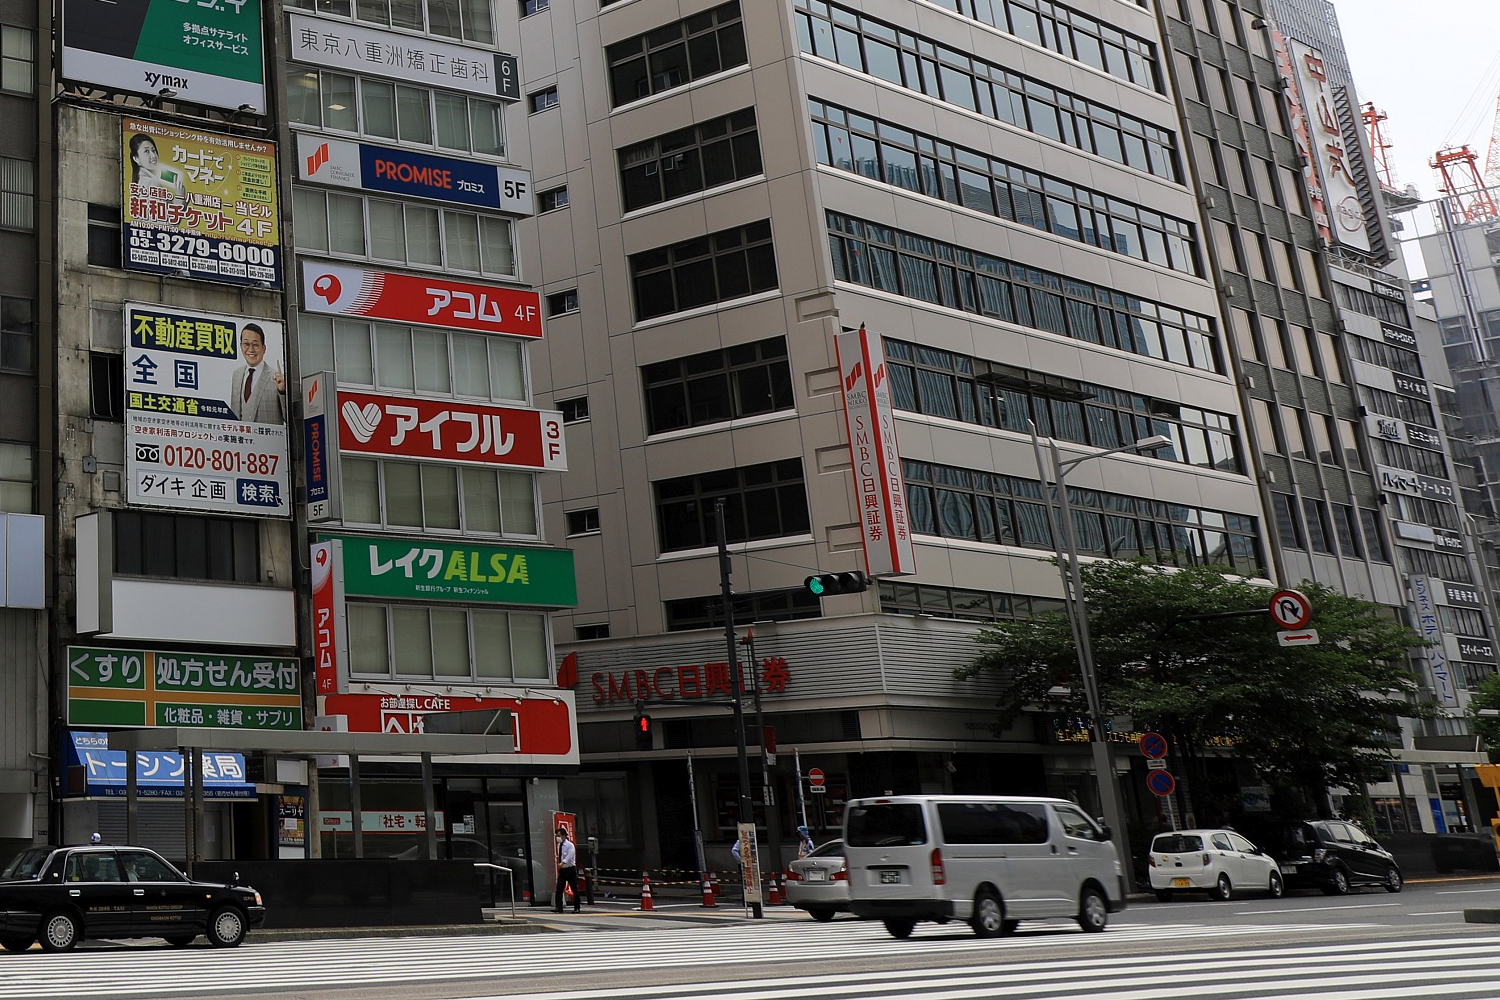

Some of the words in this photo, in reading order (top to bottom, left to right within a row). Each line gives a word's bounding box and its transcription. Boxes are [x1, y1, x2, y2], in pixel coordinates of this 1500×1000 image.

[182, 21, 248, 43] 多拠点サテライト
[182, 35, 249, 56] オフィスサービス
[299, 27, 489, 84] 東京八重洲矯正歯科
[144, 70, 188, 89] xymax
[501, 60, 511, 93] 6F
[172, 145, 224, 170] カードで
[183, 164, 225, 185] マネー
[330, 170, 355, 178] CONSUMER
[375, 159, 452, 189] PROMISE
[457, 180, 485, 194] プロミス
[504, 180, 526, 200] 5F
[185, 193, 221, 209] 八重洲店
[235, 201, 272, 219] 当ビル
[129, 197, 234, 232] 新和チケット
[130, 228, 153, 239] TEL
[236, 219, 273, 239] 4F
[130, 232, 275, 266] 03-3279-6000
[425, 287, 502, 323] アコム
[514, 304, 536, 322] 4F
[133, 314, 235, 355] 不動産買取
[132, 354, 199, 391] 全国
[129, 392, 199, 415] 国土交通省
[200, 404, 229, 415] 令和元年度
[846, 391, 867, 402] SMBC
[847, 398, 868, 409] NIKKO
[385, 405, 515, 457] アイフル
[545, 420, 561, 462] 3F
[1377, 419, 1400, 436] Hotel
[164, 444, 279, 476] 0120-801-887
[310, 422, 322, 483] PROMISE
[854, 415, 884, 542] SMBC日興証券
[882, 414, 907, 542] SMBC日興証券
[1382, 472, 1422, 493] ハイマート
[241, 482, 275, 504] 検索
[310, 486, 325, 497] プロミス
[312, 503, 324, 518] 5F
[368, 544, 530, 586] レイクALSA
[415, 584, 452, 594] 新生銀行グループ
[453, 586, 489, 596] 新生フィナンシャル
[317, 607, 332, 669] アコム
[1414, 577, 1431, 611] ビジネス
[1430, 652, 1453, 702] ハイマート
[70, 652, 141, 684] くすり
[156, 656, 298, 690] 処方せん受付
[321, 677, 332, 690] 4F
[380, 697, 422, 710] お部屋探し
[424, 698, 451, 710] CAFE
[163, 706, 293, 726] 化粧品・雑貨・サプリ
[85, 751, 243, 778] トーシン薬局
